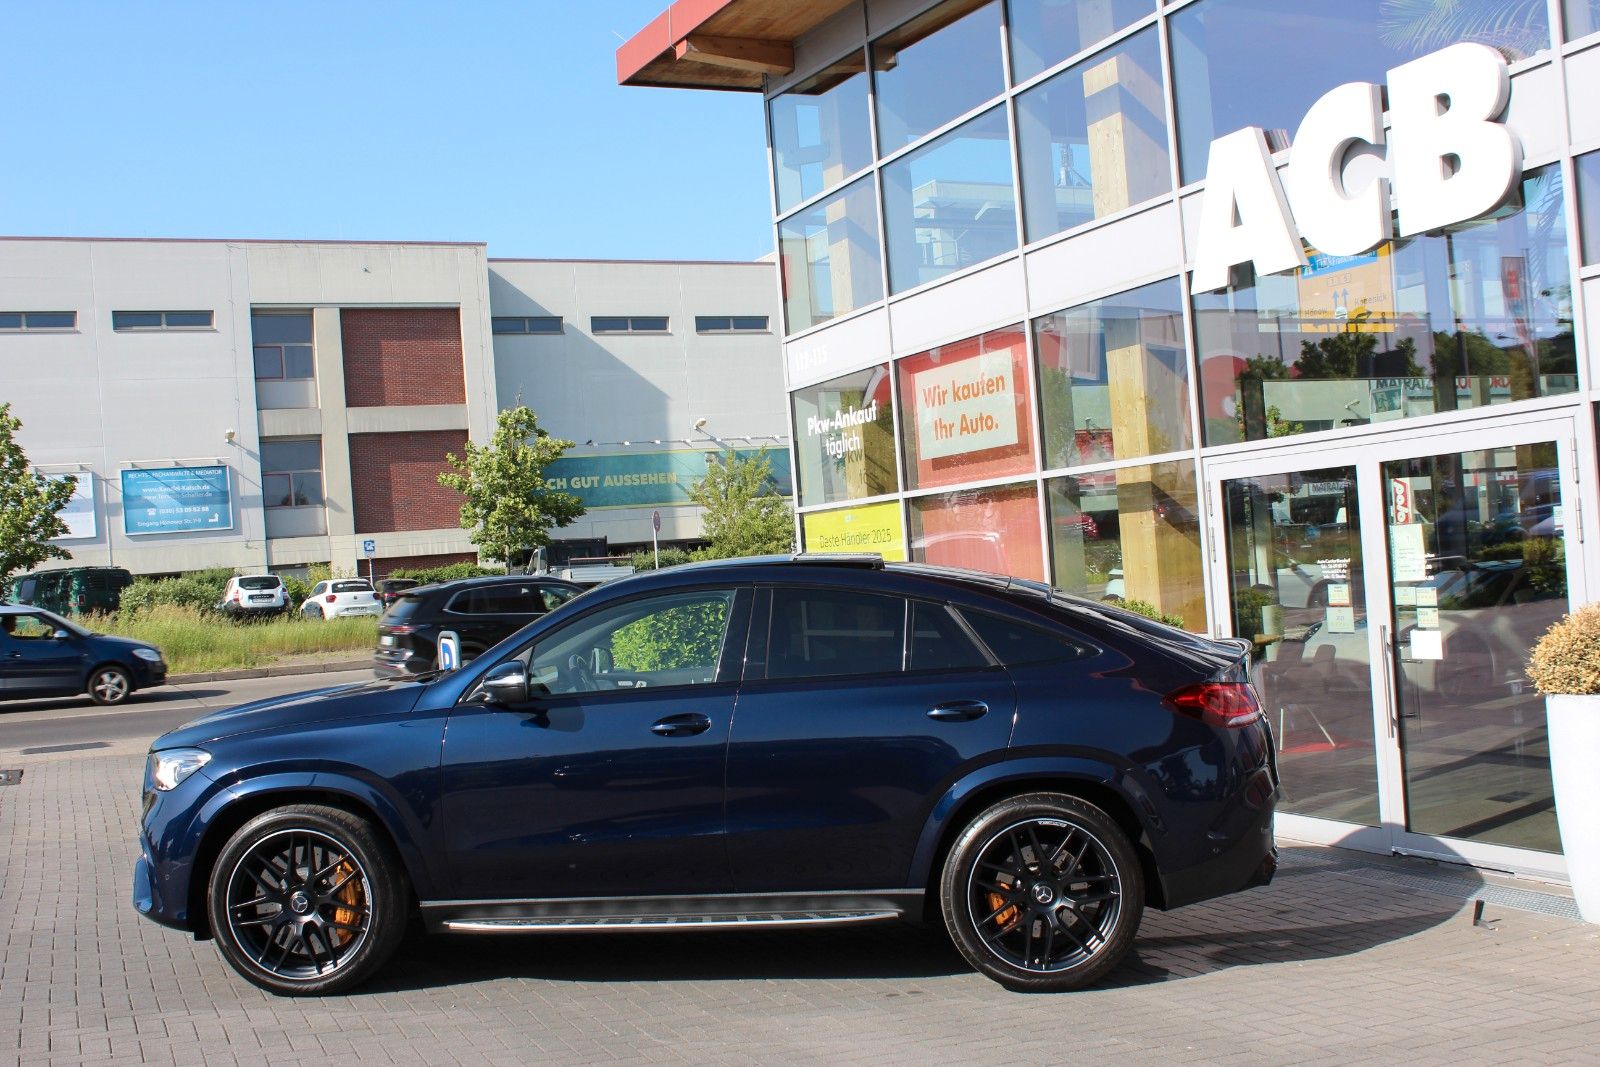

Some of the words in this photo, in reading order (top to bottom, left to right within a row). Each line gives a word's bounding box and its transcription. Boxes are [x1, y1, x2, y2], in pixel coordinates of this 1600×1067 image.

[1191, 42, 1524, 295] ACB
[923, 384, 947, 408] Wir
[952, 372, 1005, 402] kaufen
[807, 399, 876, 436] Pkw-Ankauf
[934, 418, 954, 440] Ihr
[960, 413, 998, 436] Auto.
[825, 430, 861, 459] täglich
[571, 476, 599, 489] GUT
[604, 472, 677, 487] AUSSEHEN
[820, 533, 840, 548] Beste
[872, 529, 892, 543] 2025
